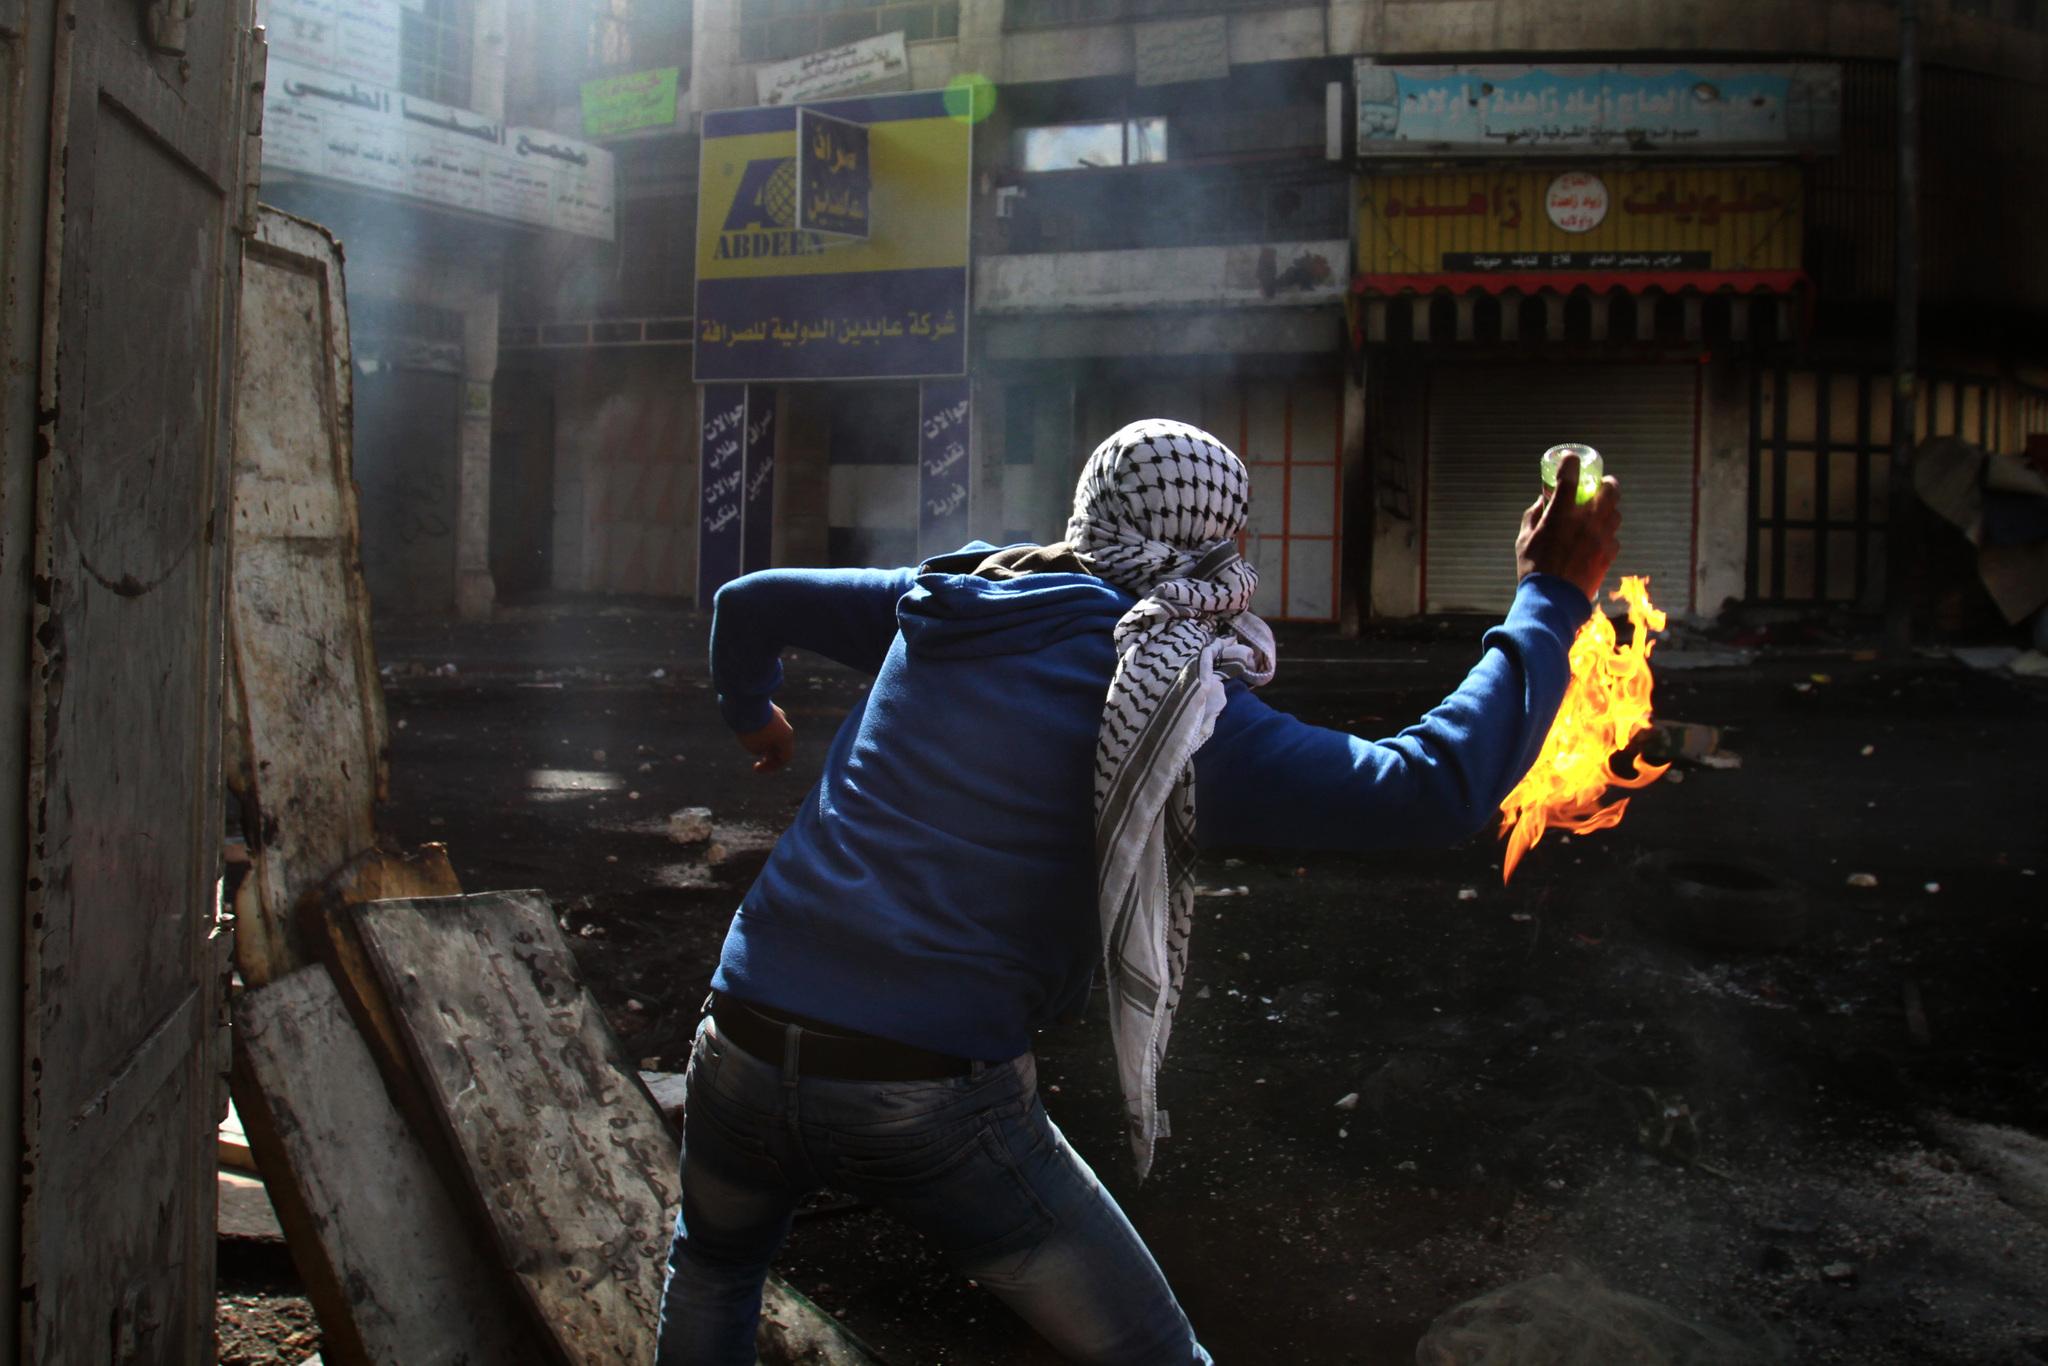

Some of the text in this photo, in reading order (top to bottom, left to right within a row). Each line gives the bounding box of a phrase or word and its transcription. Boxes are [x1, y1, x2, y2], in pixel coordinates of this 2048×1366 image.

[283, 79, 389, 114] الطبي
[402, 96, 506, 147] الصفا
[516, 135, 588, 167] مجمع
[701, 310, 955, 347] شركة عابدين الدولية للصرافة
[704, 404, 743, 440] حوالات
[923, 400, 968, 439] حوالات
[923, 441, 964, 476] نقدية
[704, 470, 741, 503] حوالات
